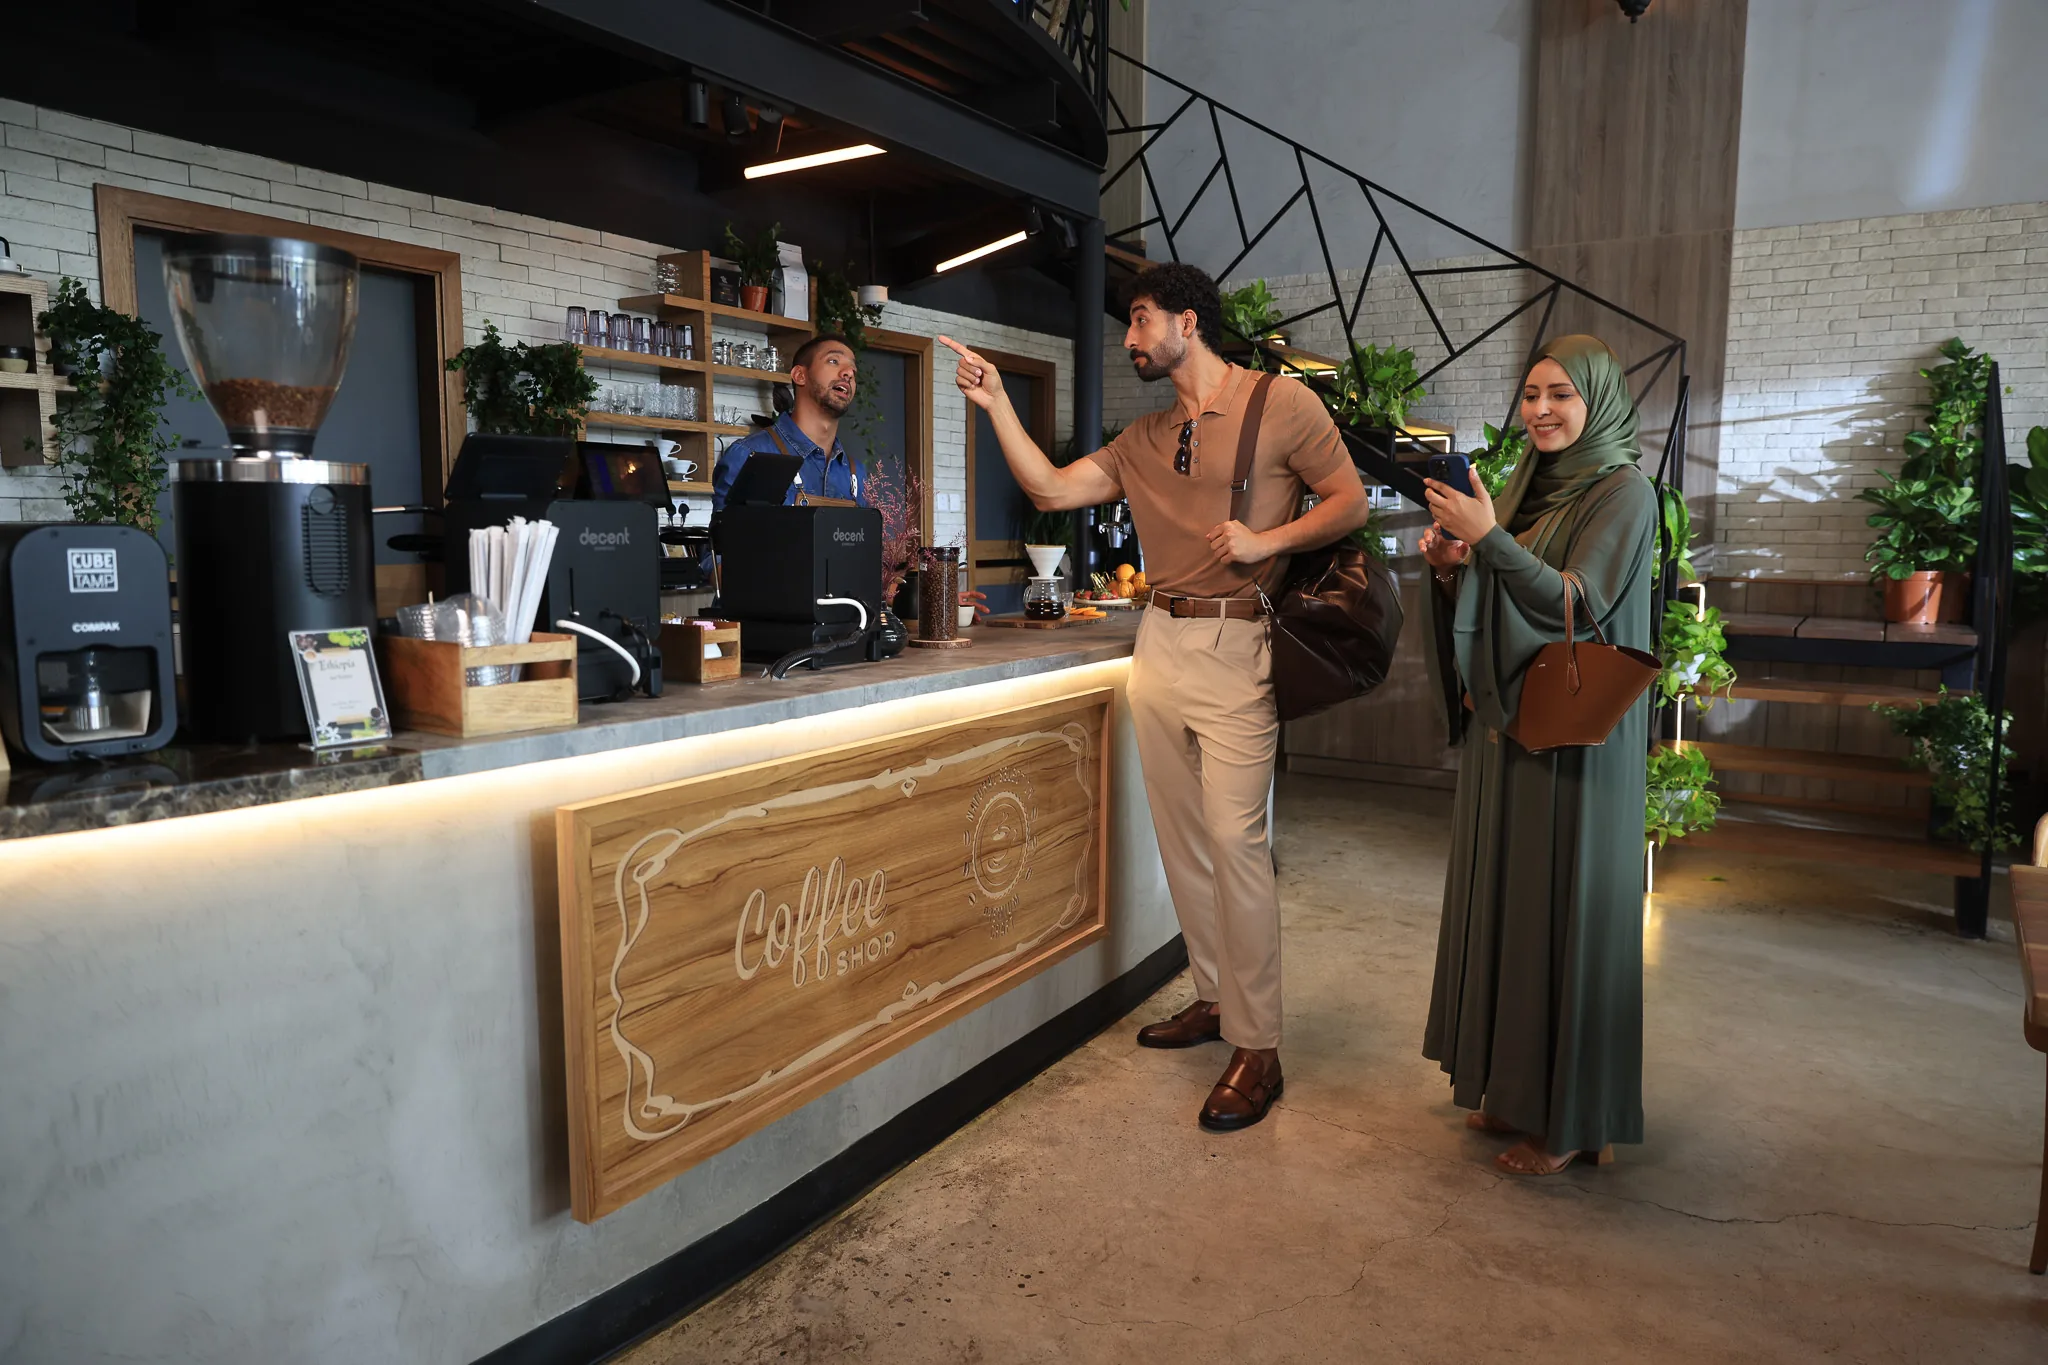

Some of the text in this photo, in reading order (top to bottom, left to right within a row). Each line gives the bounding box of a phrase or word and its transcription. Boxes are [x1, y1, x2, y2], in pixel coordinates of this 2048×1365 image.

[579, 526, 630, 546] decent
[833, 527, 865, 542] decent
[72, 553, 113, 569] CUBE
[74, 574, 115, 589] TAMP
[72, 622, 120, 633] COMPAK
[735, 856, 888, 988] Coffee
[836, 930, 896, 976] SHOP
